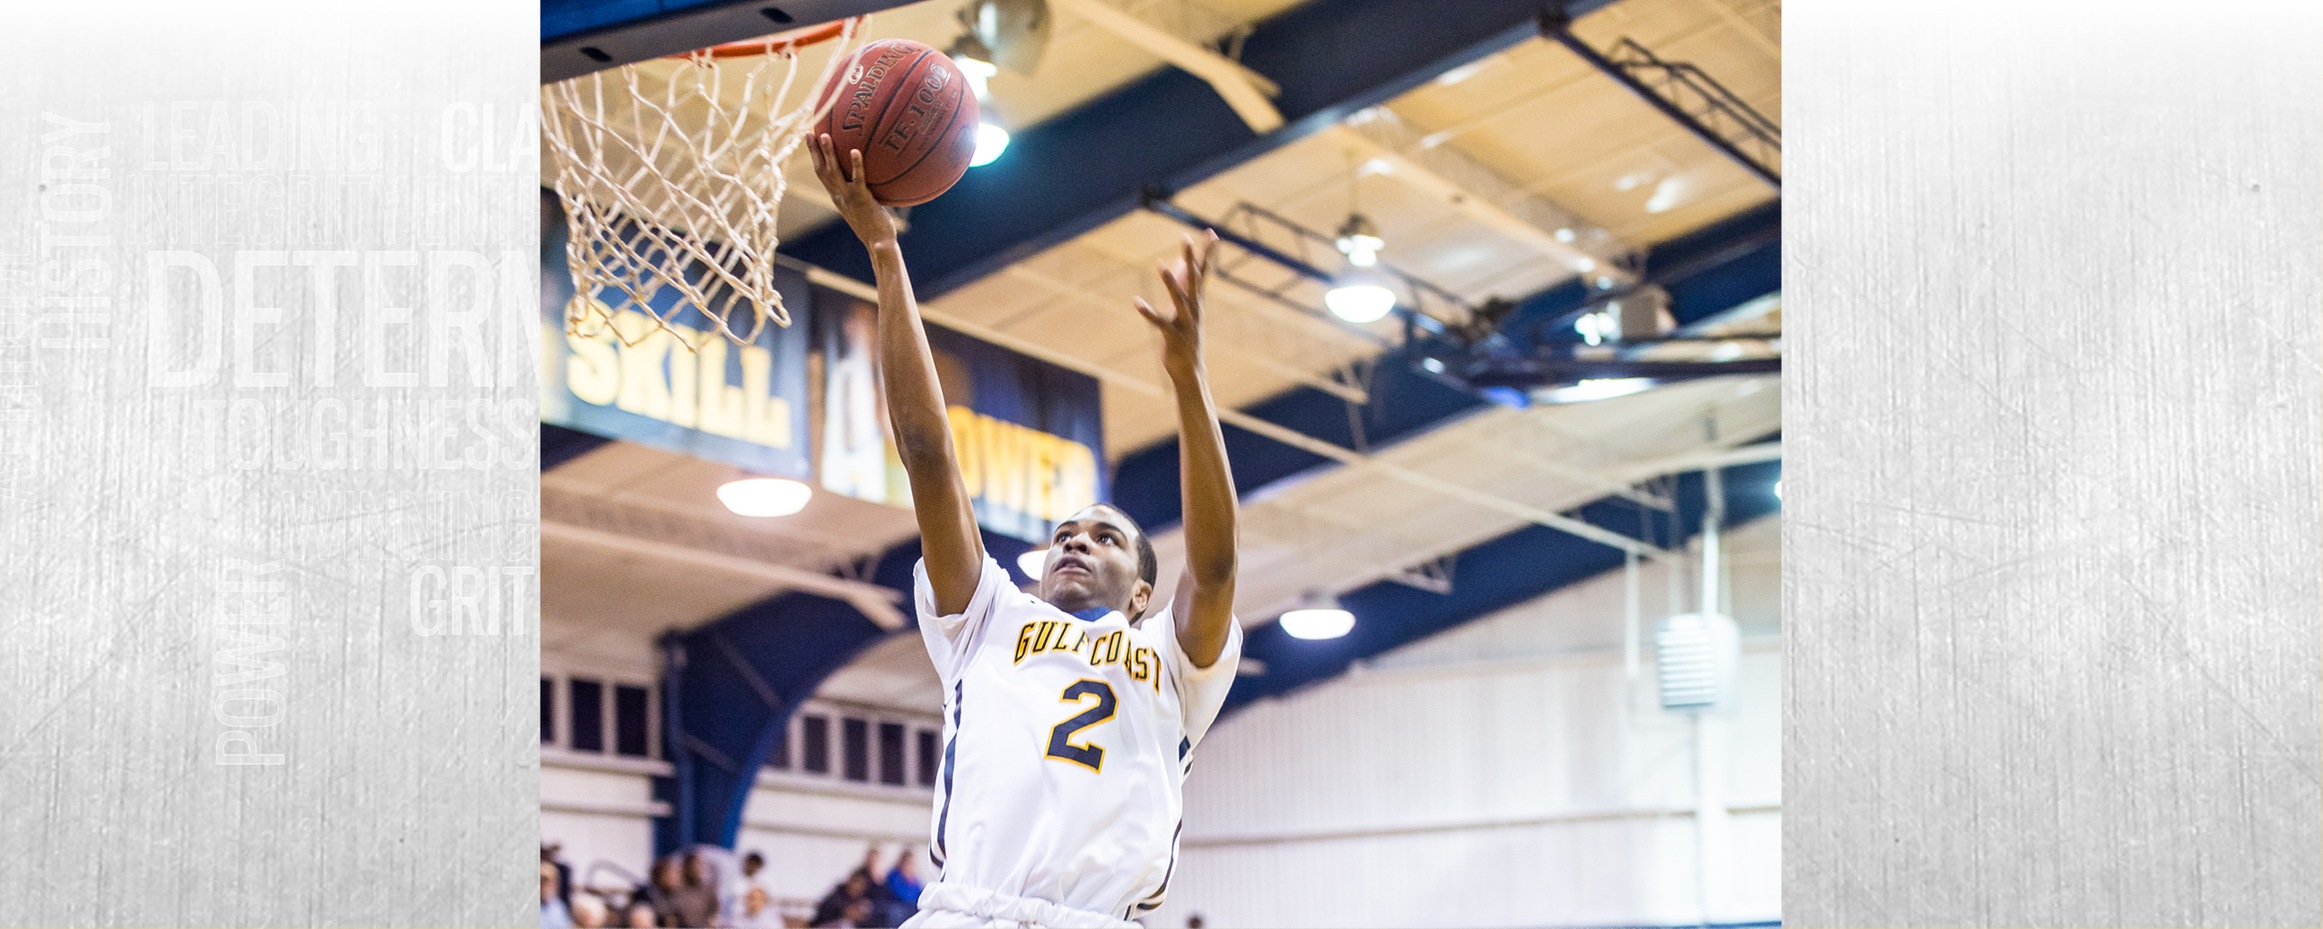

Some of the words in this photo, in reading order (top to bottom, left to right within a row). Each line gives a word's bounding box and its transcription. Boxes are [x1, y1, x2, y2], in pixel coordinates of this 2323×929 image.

[842, 41, 914, 137] SPALDING
[565, 294, 790, 449] SKILL
[947, 404, 1097, 522] OWER
[1013, 620, 1089, 666] GULF
[1089, 629, 1162, 697] COAST
[1044, 677, 1119, 775] 2
